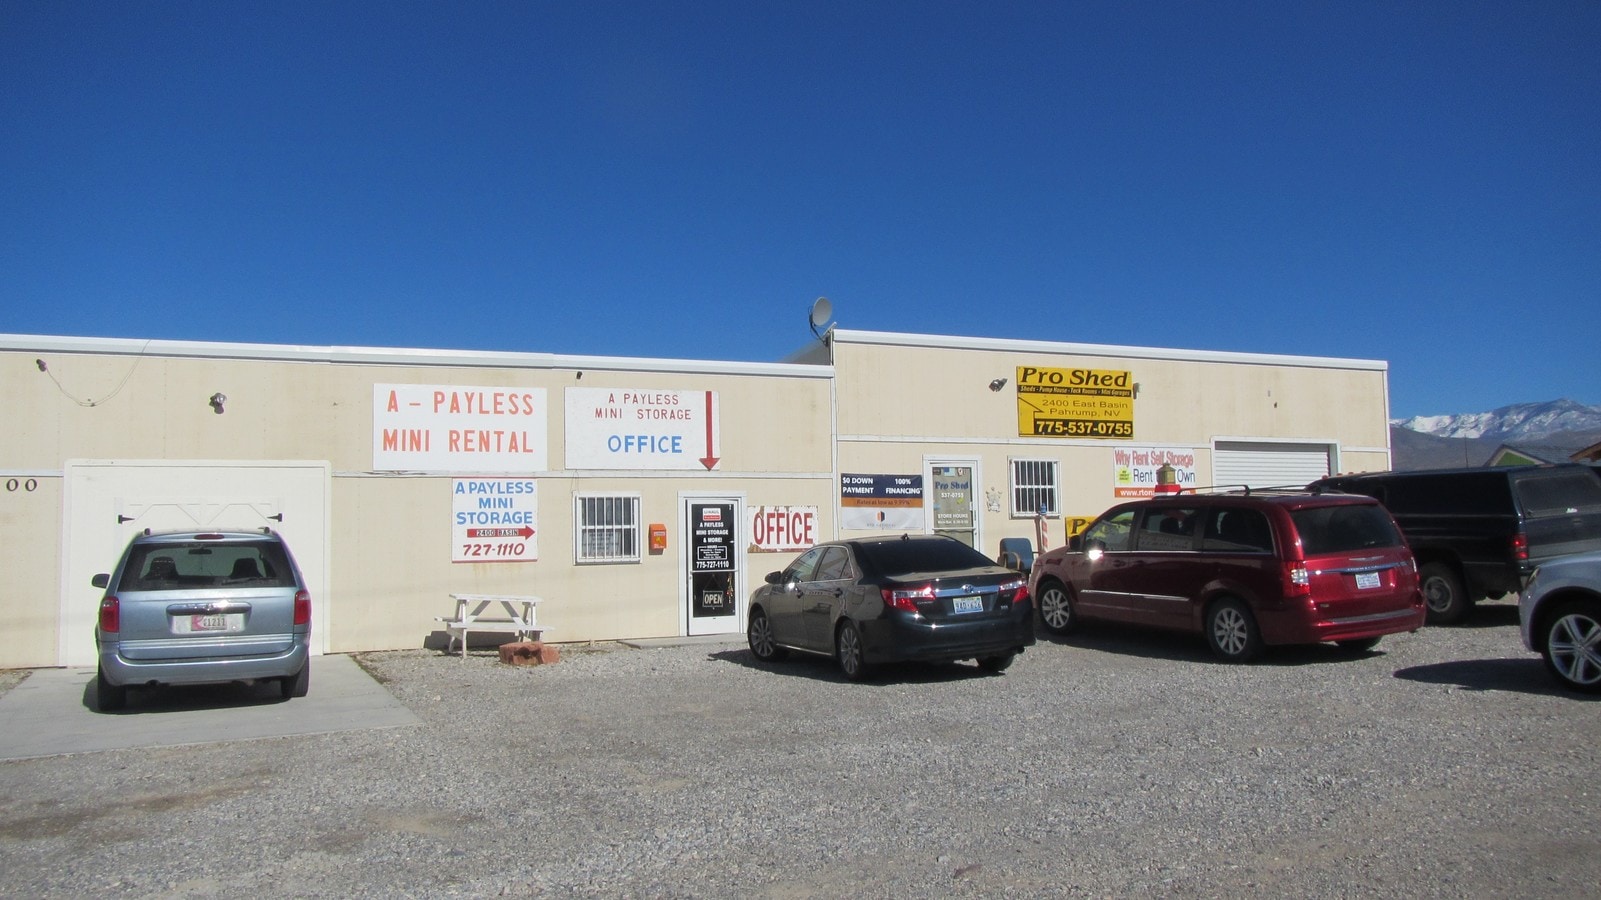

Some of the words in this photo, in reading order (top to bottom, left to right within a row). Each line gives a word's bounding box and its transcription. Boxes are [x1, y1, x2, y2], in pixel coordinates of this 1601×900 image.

[1021, 367, 1063, 384] Pro
[1070, 370, 1128, 387] Shed
[1039, 386, 1052, 394] Pump
[387, 390, 399, 412] A
[433, 391, 534, 416] PAYLESS
[608, 393, 616, 404] A
[624, 394, 679, 406] PAYLESS
[1042, 399, 1069, 407] 2400
[1073, 400, 1096, 408] East
[1100, 400, 1128, 409] Basin
[595, 408, 623, 420] MINI
[637, 409, 692, 420] STORAGE
[1036, 421, 1132, 435] 775-537-0755
[383, 428, 430, 452] MINI
[449, 430, 534, 453] RENTAL
[608, 435, 682, 454] OFFICE
[1115, 450, 1130, 468] Why
[1132, 450, 1149, 466] Rent
[1166, 451, 1194, 468] Storage
[1134, 468, 1153, 482] Rent
[1177, 468, 1196, 482] Own
[455, 482, 465, 494] A
[469, 482, 534, 494] PAYLESS
[935, 481, 948, 490] Pro
[950, 481, 969, 490] Shed
[478, 497, 513, 509] MINI
[456, 511, 533, 525] STORAGE
[476, 529, 496, 537] 2400
[753, 512, 814, 545] OFFICE
[463, 543, 525, 556] 727-1110
[704, 594, 722, 604] OPEN
